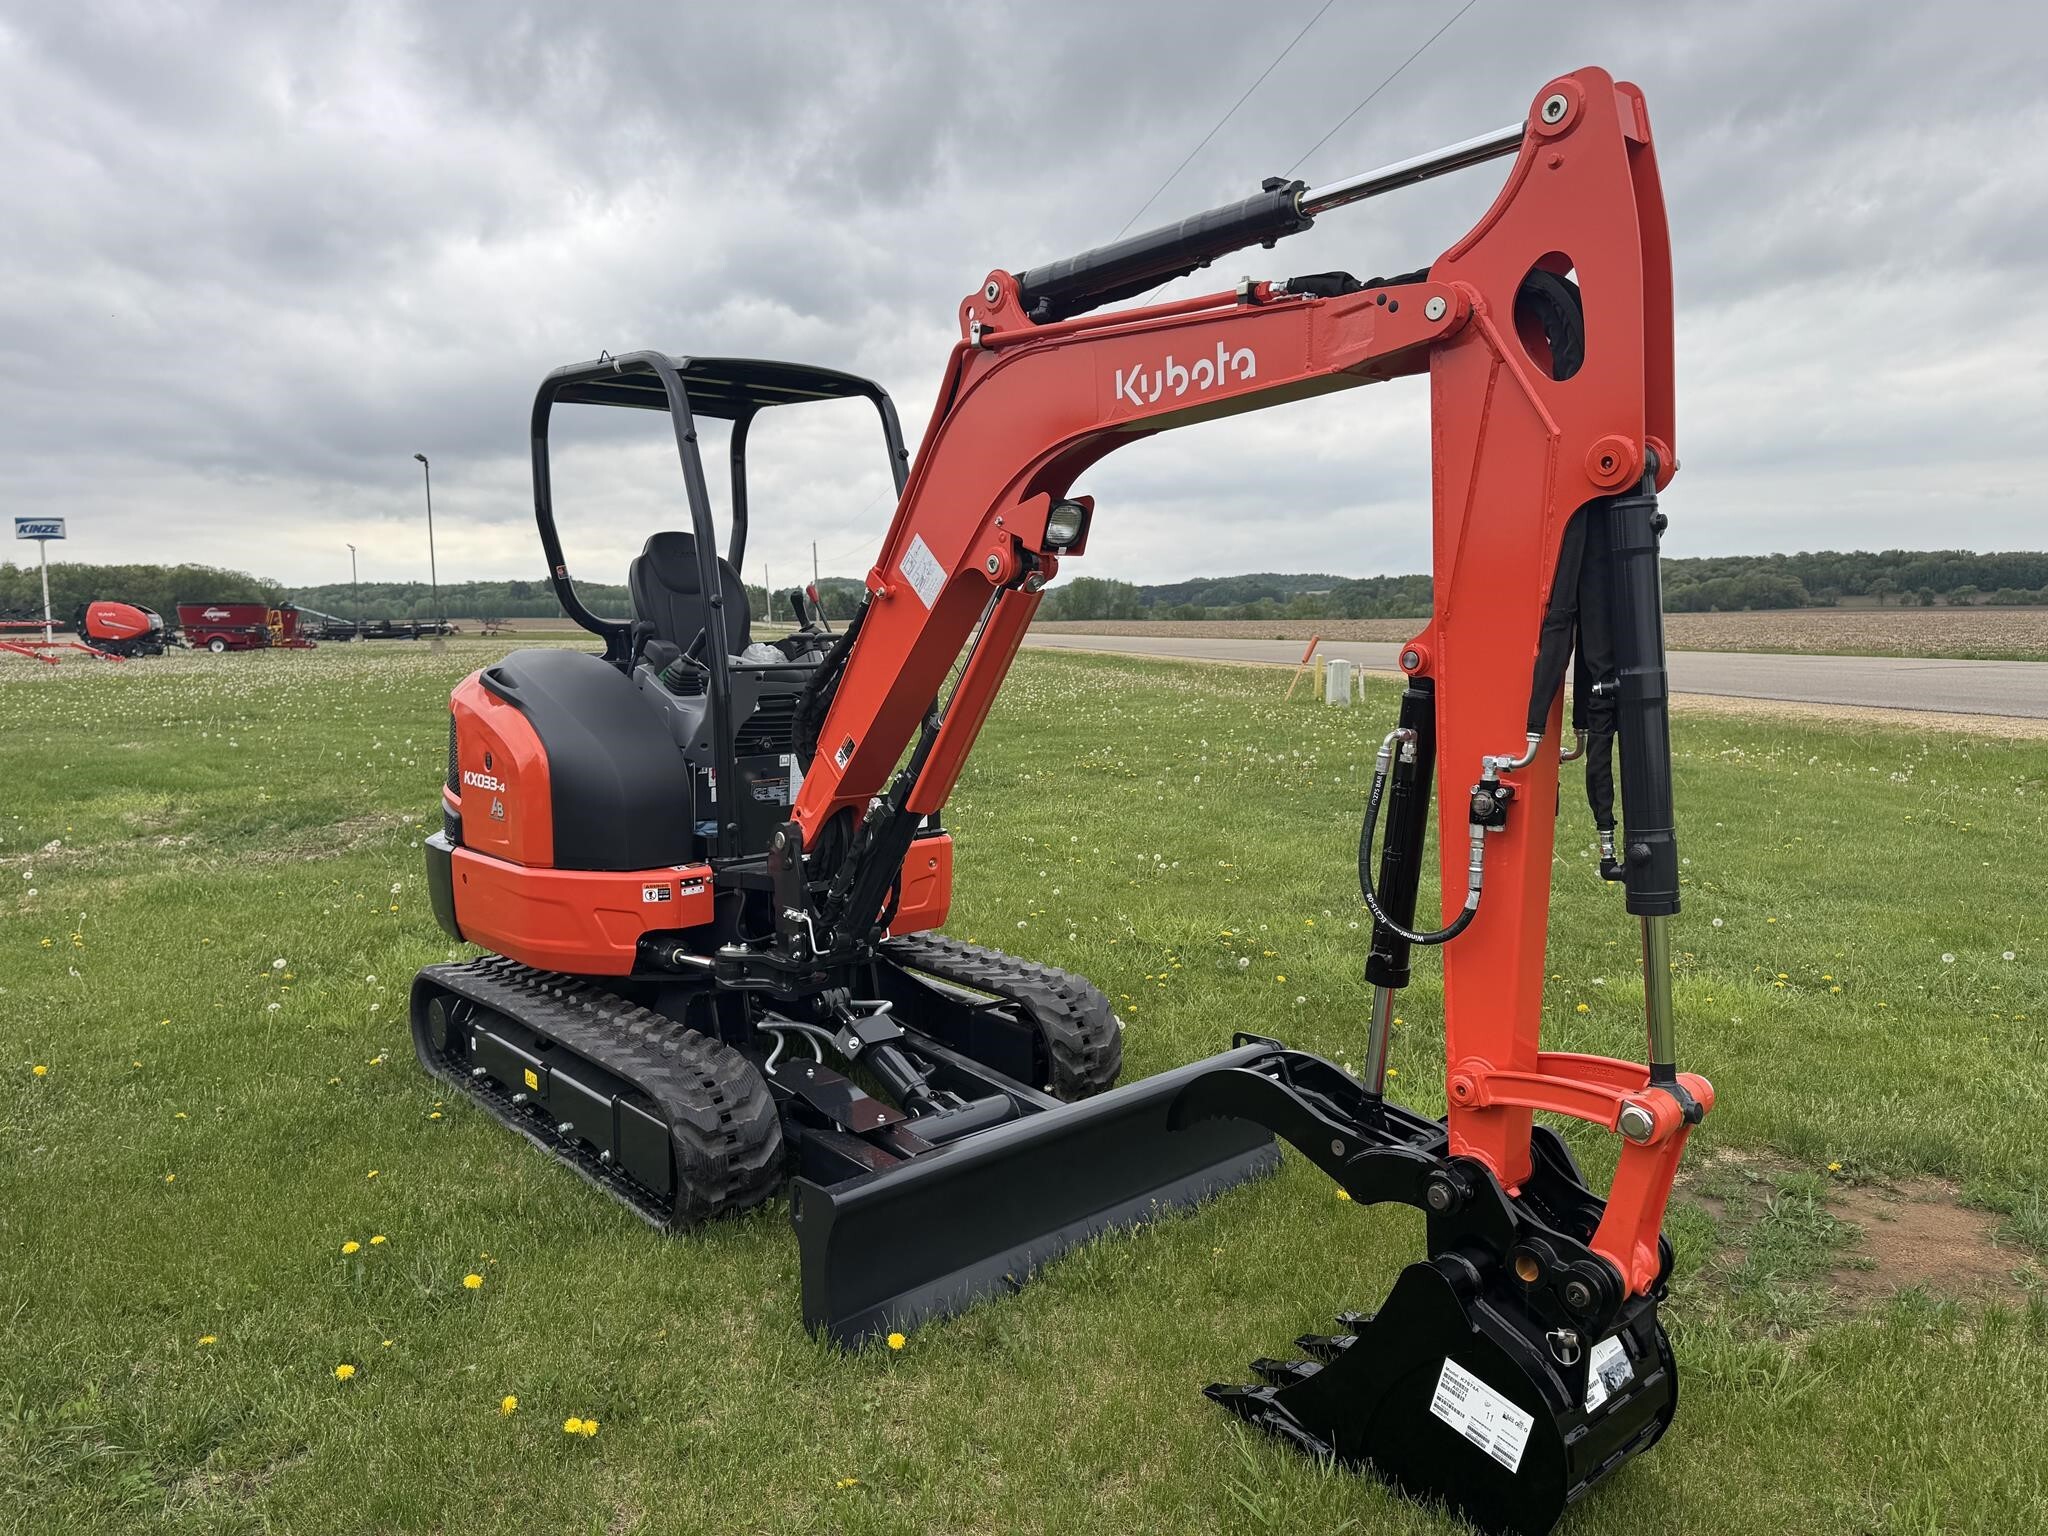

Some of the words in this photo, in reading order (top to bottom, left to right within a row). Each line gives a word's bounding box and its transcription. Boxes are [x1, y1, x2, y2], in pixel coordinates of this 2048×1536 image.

[1116, 341, 1256, 406] Kubota
[18, 524, 61, 534] KINZE
[464, 770, 506, 793] KX033-4
[1400, 931, 1425, 943] Winner
